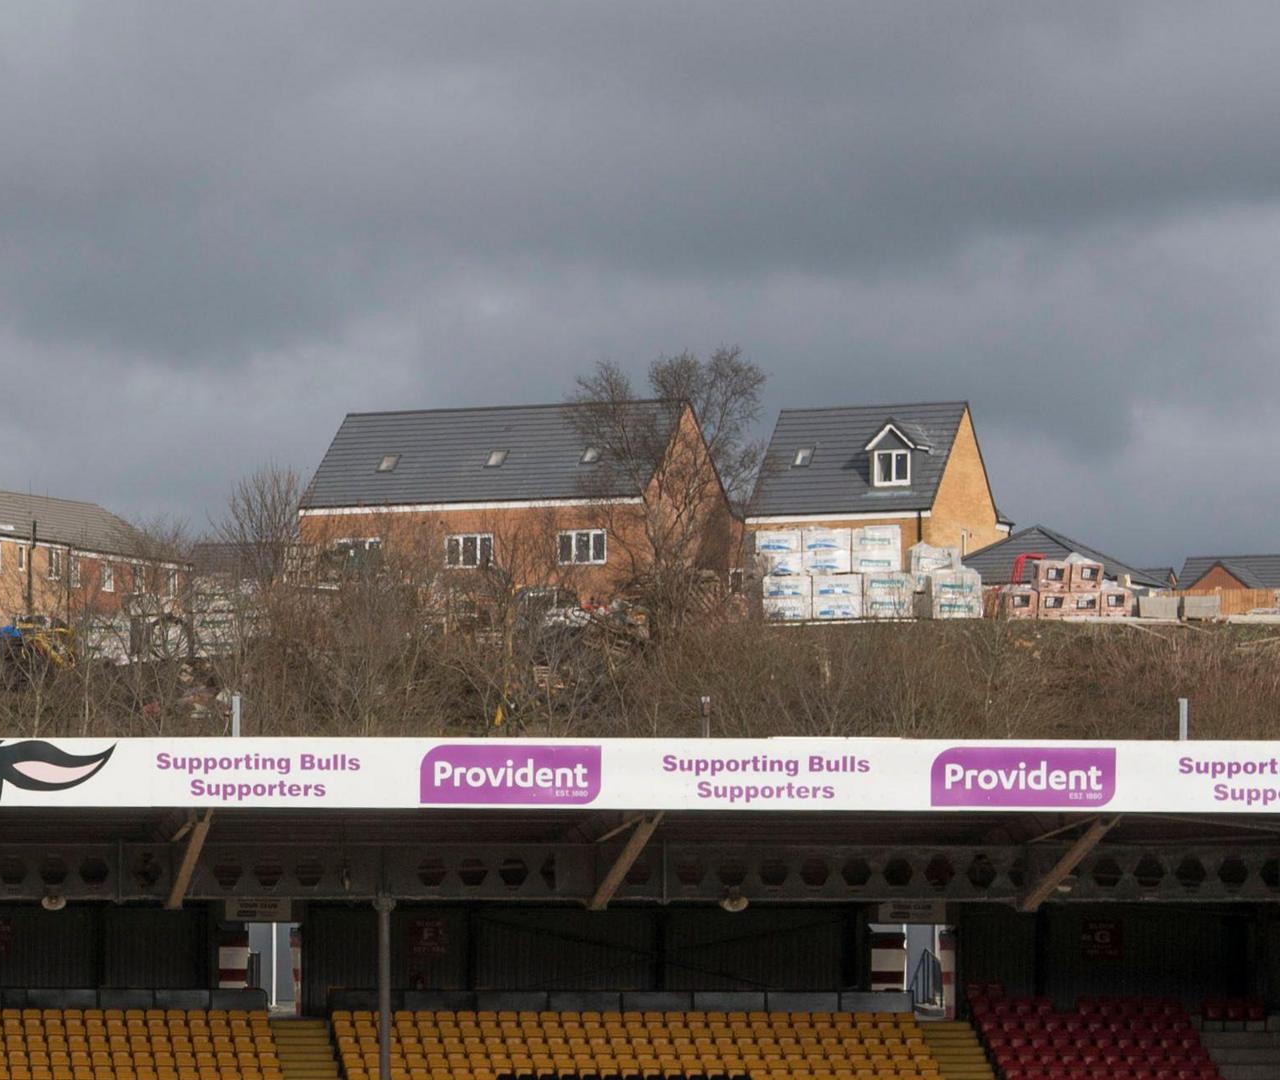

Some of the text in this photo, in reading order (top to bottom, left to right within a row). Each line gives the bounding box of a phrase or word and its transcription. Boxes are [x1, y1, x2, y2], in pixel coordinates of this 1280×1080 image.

[156, 752, 361, 775] Supporting Bulls
[434, 758, 589, 788] Provident
[662, 754, 871, 776] Supporting Bulls
[1179, 756, 1280, 779] Support
[944, 761, 1103, 791] Provident
[190, 779, 326, 801] Supporters
[697, 780, 835, 803] Supporters
